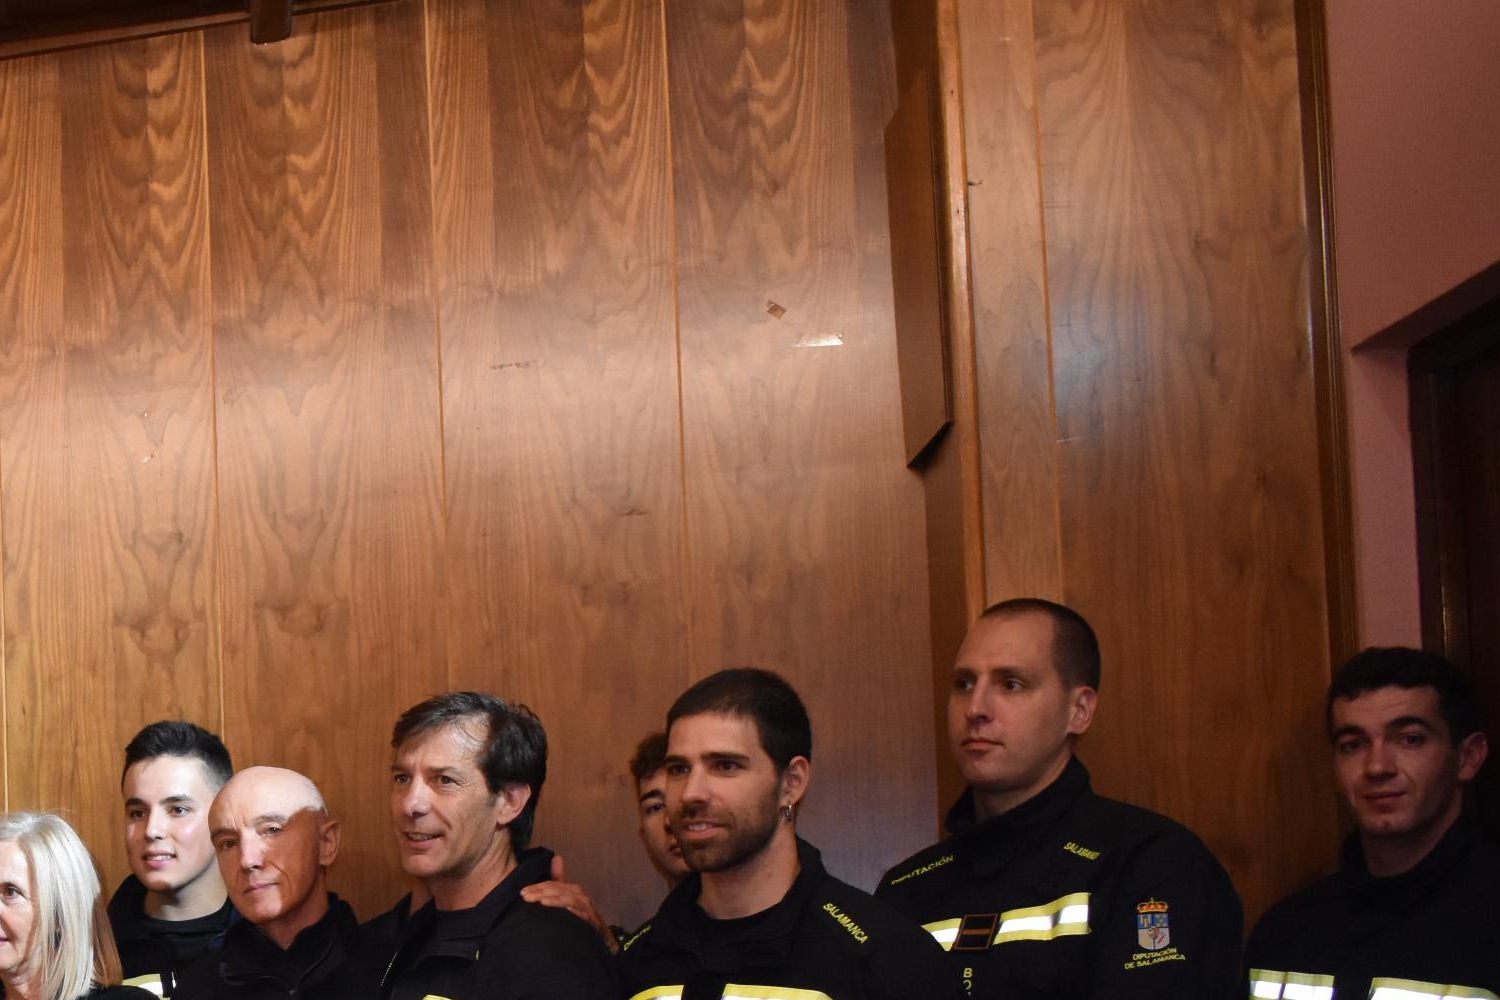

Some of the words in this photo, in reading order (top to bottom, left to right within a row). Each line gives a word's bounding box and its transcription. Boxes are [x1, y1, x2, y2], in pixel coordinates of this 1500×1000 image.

[823, 902, 868, 943] SALAMANCA
[1124, 962, 1135, 970] DE
[1136, 954, 1186, 967] SALAMANCA
[1132, 948, 1177, 960] DIPUTACIÓN
[963, 967, 973, 996] BO
